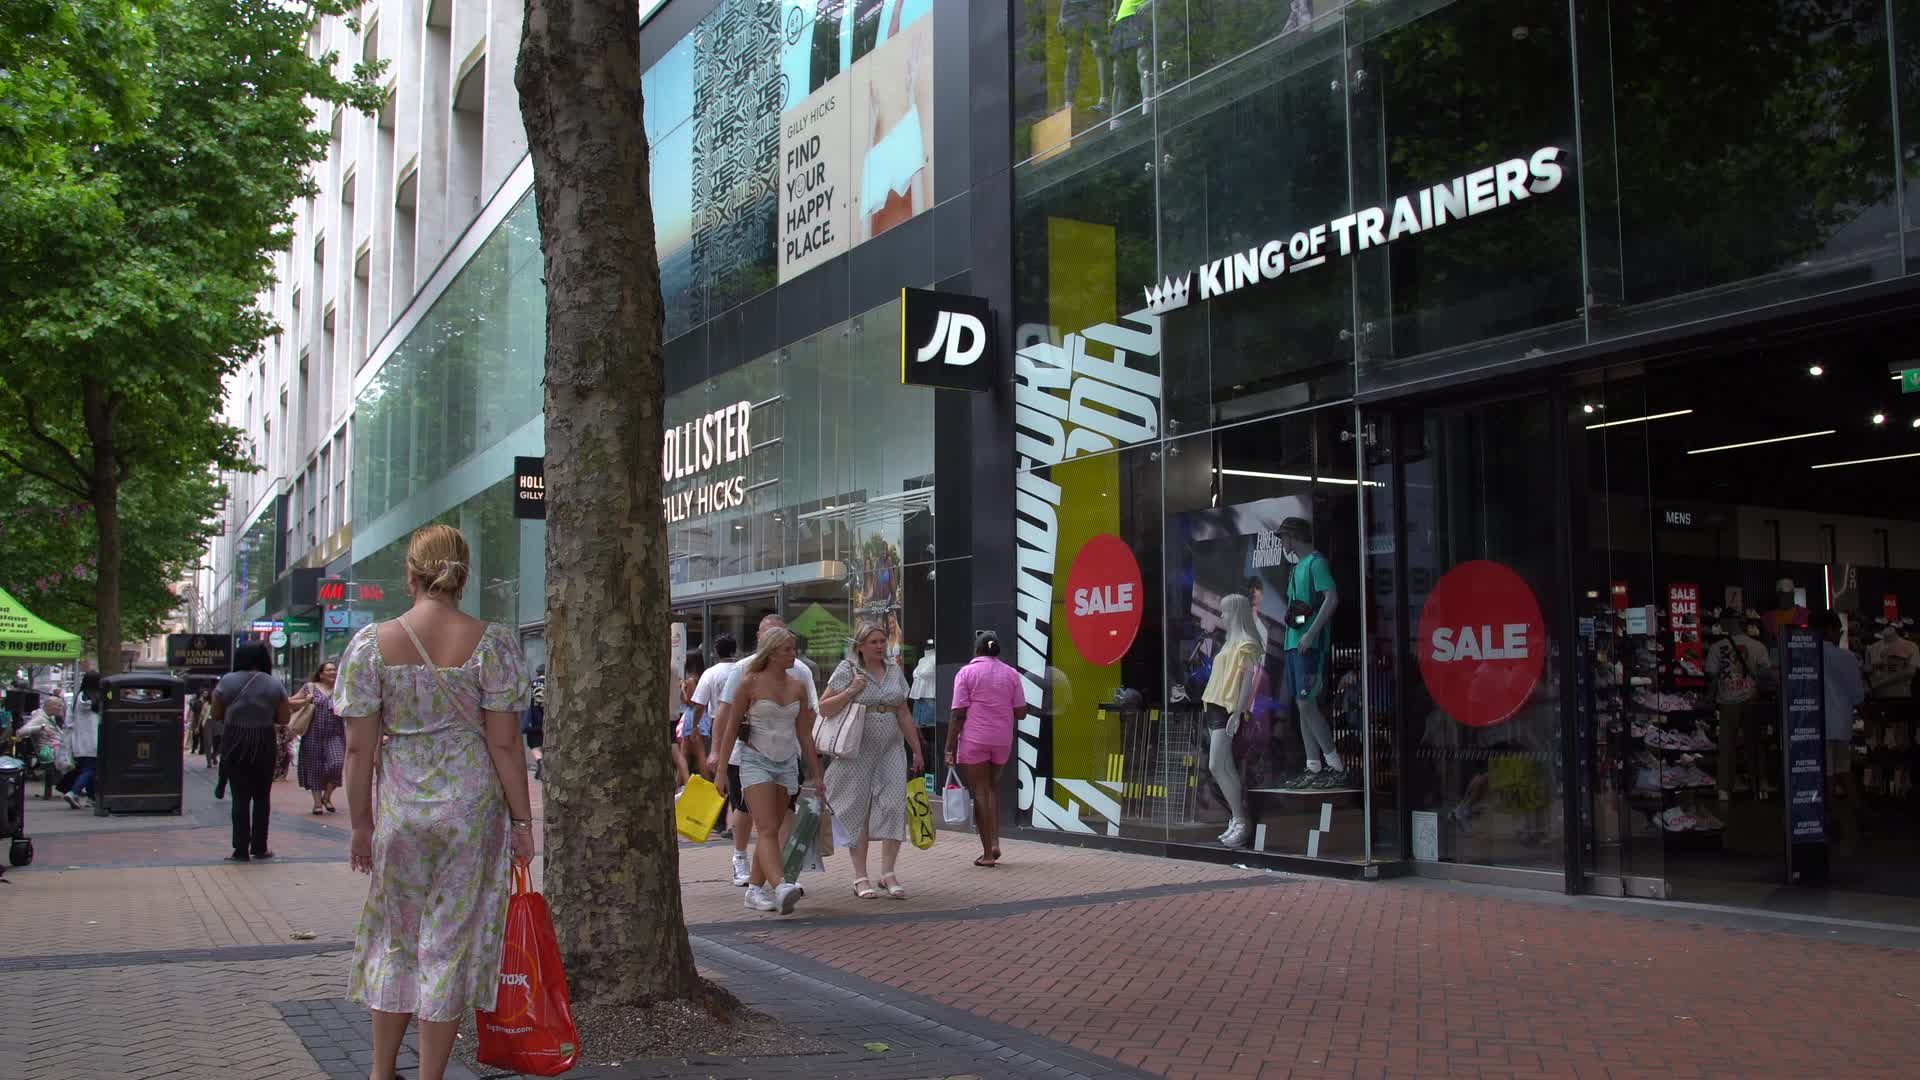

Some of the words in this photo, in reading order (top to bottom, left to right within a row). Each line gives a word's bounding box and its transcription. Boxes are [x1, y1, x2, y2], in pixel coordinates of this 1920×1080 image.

[787, 115, 809, 139] GILLY
[810, 96, 836, 123] HICKS
[787, 135, 821, 175] FIND
[787, 185, 835, 234] HAPPY
[1200, 239, 1285, 301] KING
[1290, 225, 1327, 262] OF
[1331, 146, 1567, 257] TRAINERS
[786, 219, 835, 265] PLACE.
[917, 310, 986, 366] JD
[520, 475, 545, 489] HOLL
[520, 491, 544, 500] GILLY
[698, 475, 745, 516] HICKS
[1666, 511, 1692, 526] MENS
[1073, 583, 1134, 617] SALE
[1671, 588, 1696, 600] SALE
[1672, 602, 1697, 614] SALE
[9, 641, 23, 650] no
[176, 649, 225, 657] ITANNIA
[1431, 623, 1529, 662] SALE
